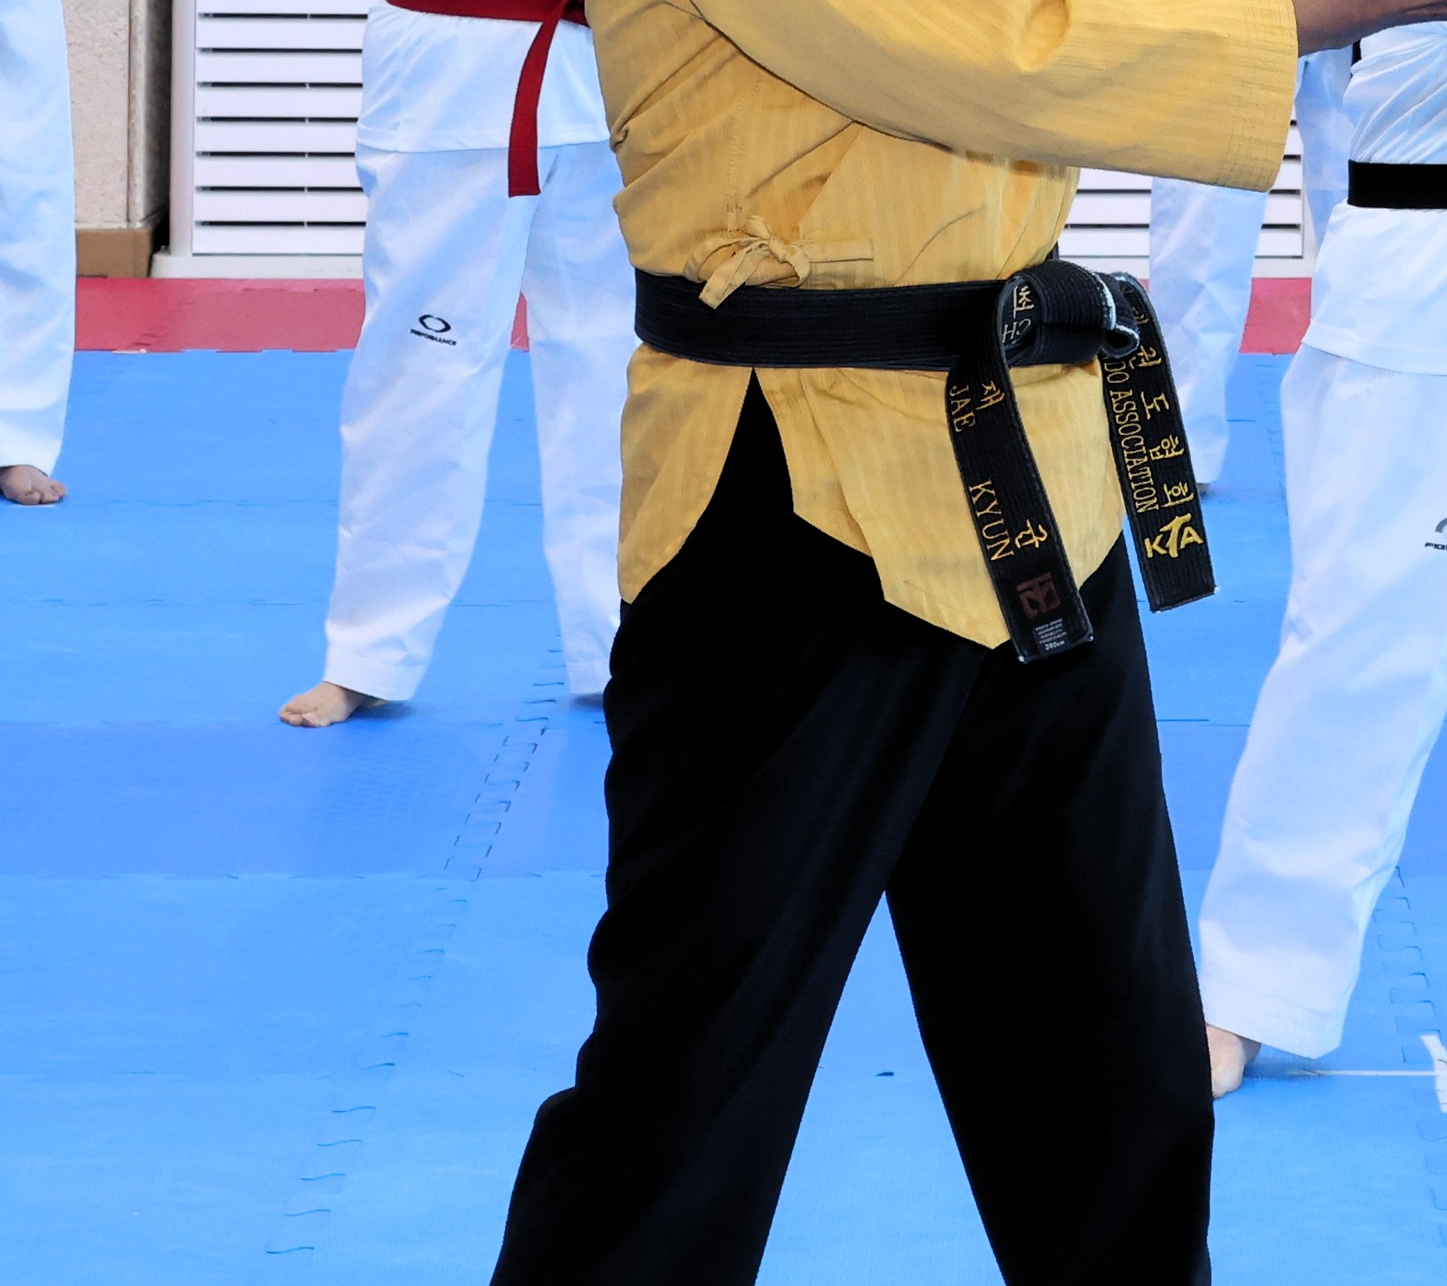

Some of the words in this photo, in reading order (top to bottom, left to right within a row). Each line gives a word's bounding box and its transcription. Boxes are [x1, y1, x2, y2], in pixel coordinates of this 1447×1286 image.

[948, 383, 977, 434] JAE
[968, 479, 1015, 562] KYUN
[1108, 389, 1160, 514] ASSOCIATION
[1143, 512, 1204, 559] KTA
